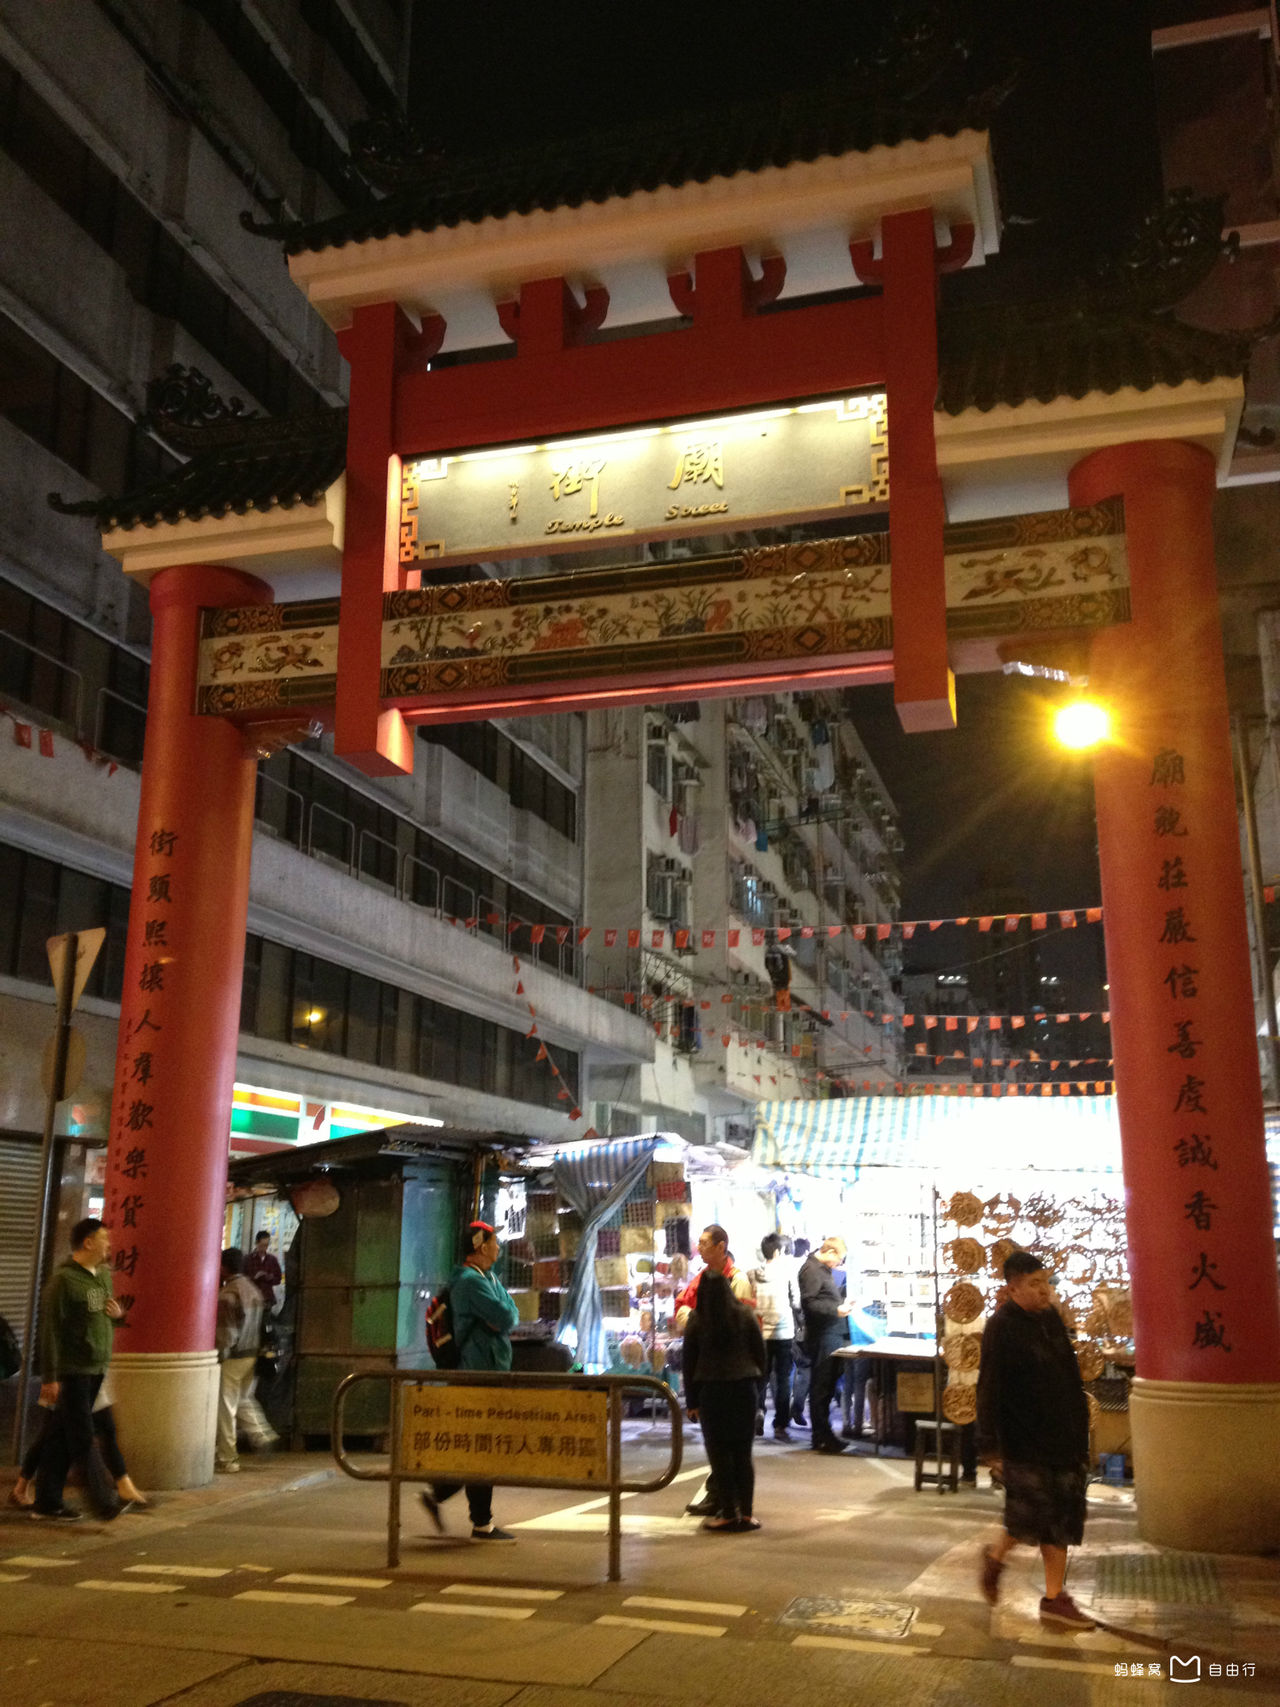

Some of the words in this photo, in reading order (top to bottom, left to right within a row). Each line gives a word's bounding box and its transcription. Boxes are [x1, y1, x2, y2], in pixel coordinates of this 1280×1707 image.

[545, 512, 625, 534] Temple
[665, 501, 729, 520] Street
[487, 1407, 561, 1421] Pedestrian
[564, 1410, 597, 1423] Area
[414, 1432, 598, 1457] 部份時間行人專用區
